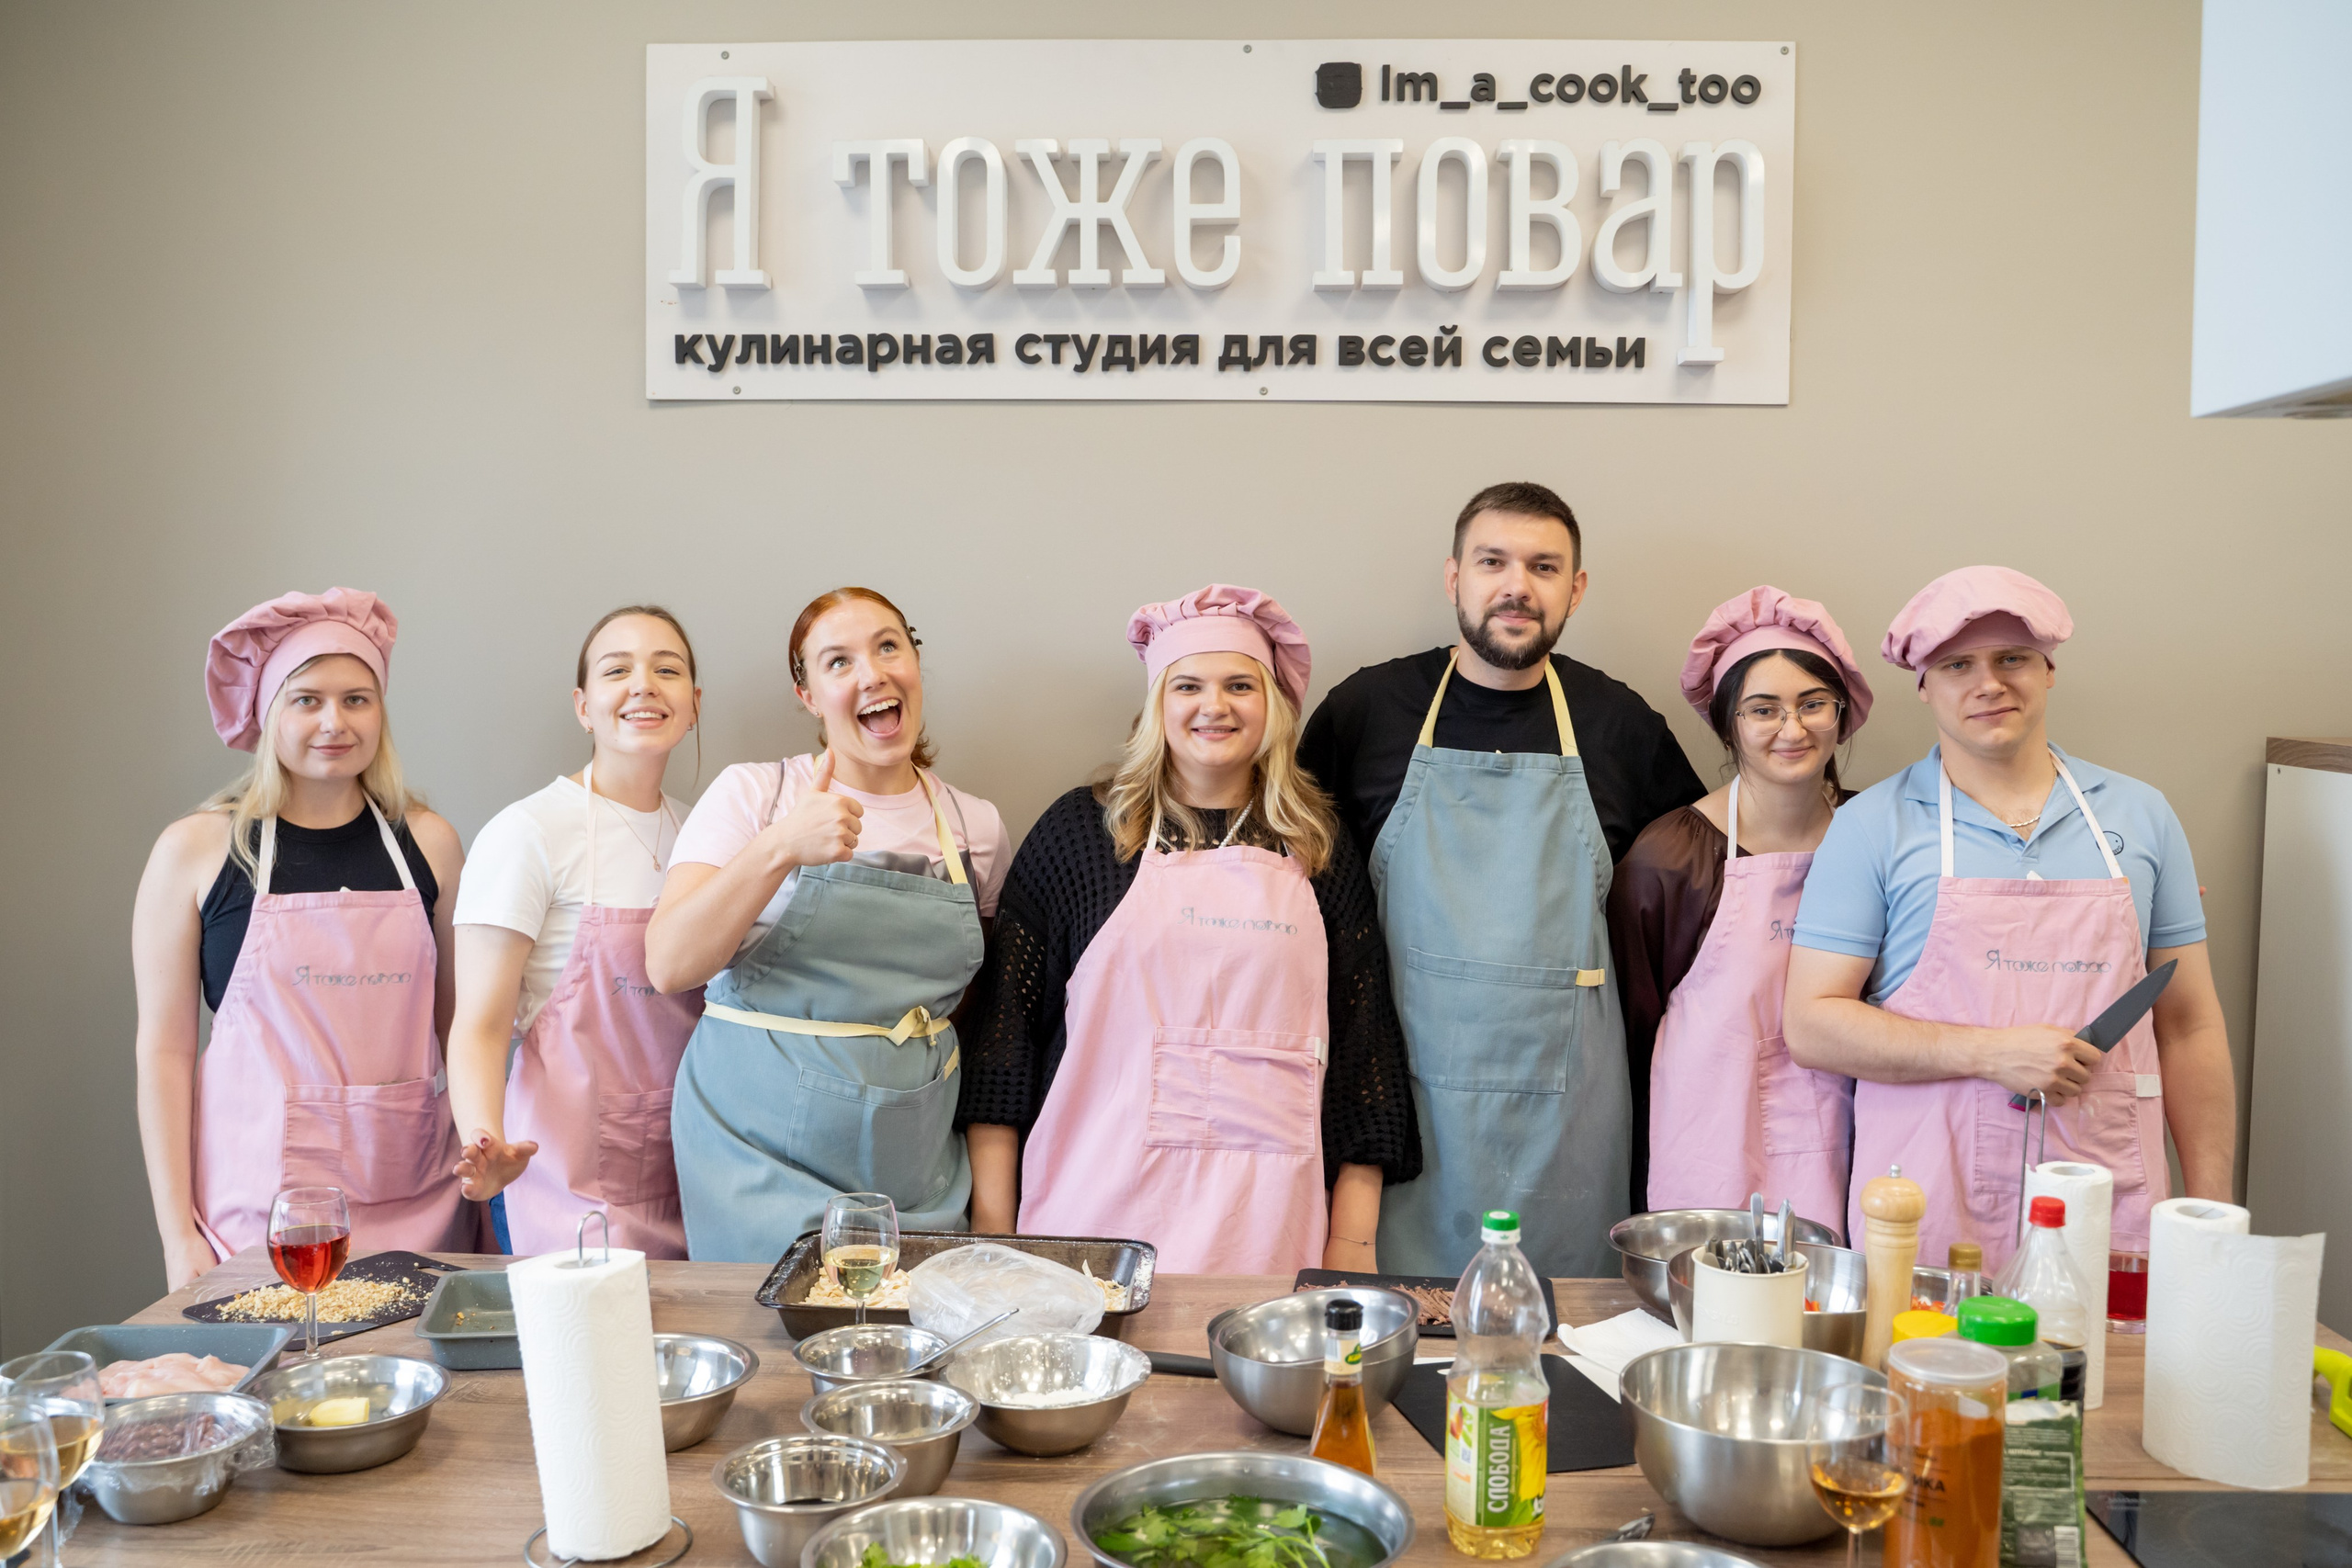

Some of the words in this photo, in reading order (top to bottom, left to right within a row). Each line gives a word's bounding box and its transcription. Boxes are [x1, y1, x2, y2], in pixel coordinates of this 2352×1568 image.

[668, 75, 775, 290] Я
[832, 136, 1241, 292] тоже
[1311, 136, 1766, 367] повар
[674, 333, 995, 372] кулинарная
[1015, 333, 1200, 372] студия
[1218, 333, 1317, 372] для
[1338, 324, 1463, 367] всей
[1482, 334, 1646, 368] семьи
[1178, 906, 1194, 926] Я
[1769, 919, 1783, 941] Я
[1984, 949, 2001, 971] Я
[292, 964, 310, 987] Я
[611, 976, 628, 997] Я
[1487, 1424, 1510, 1513] СЛОБОДА
